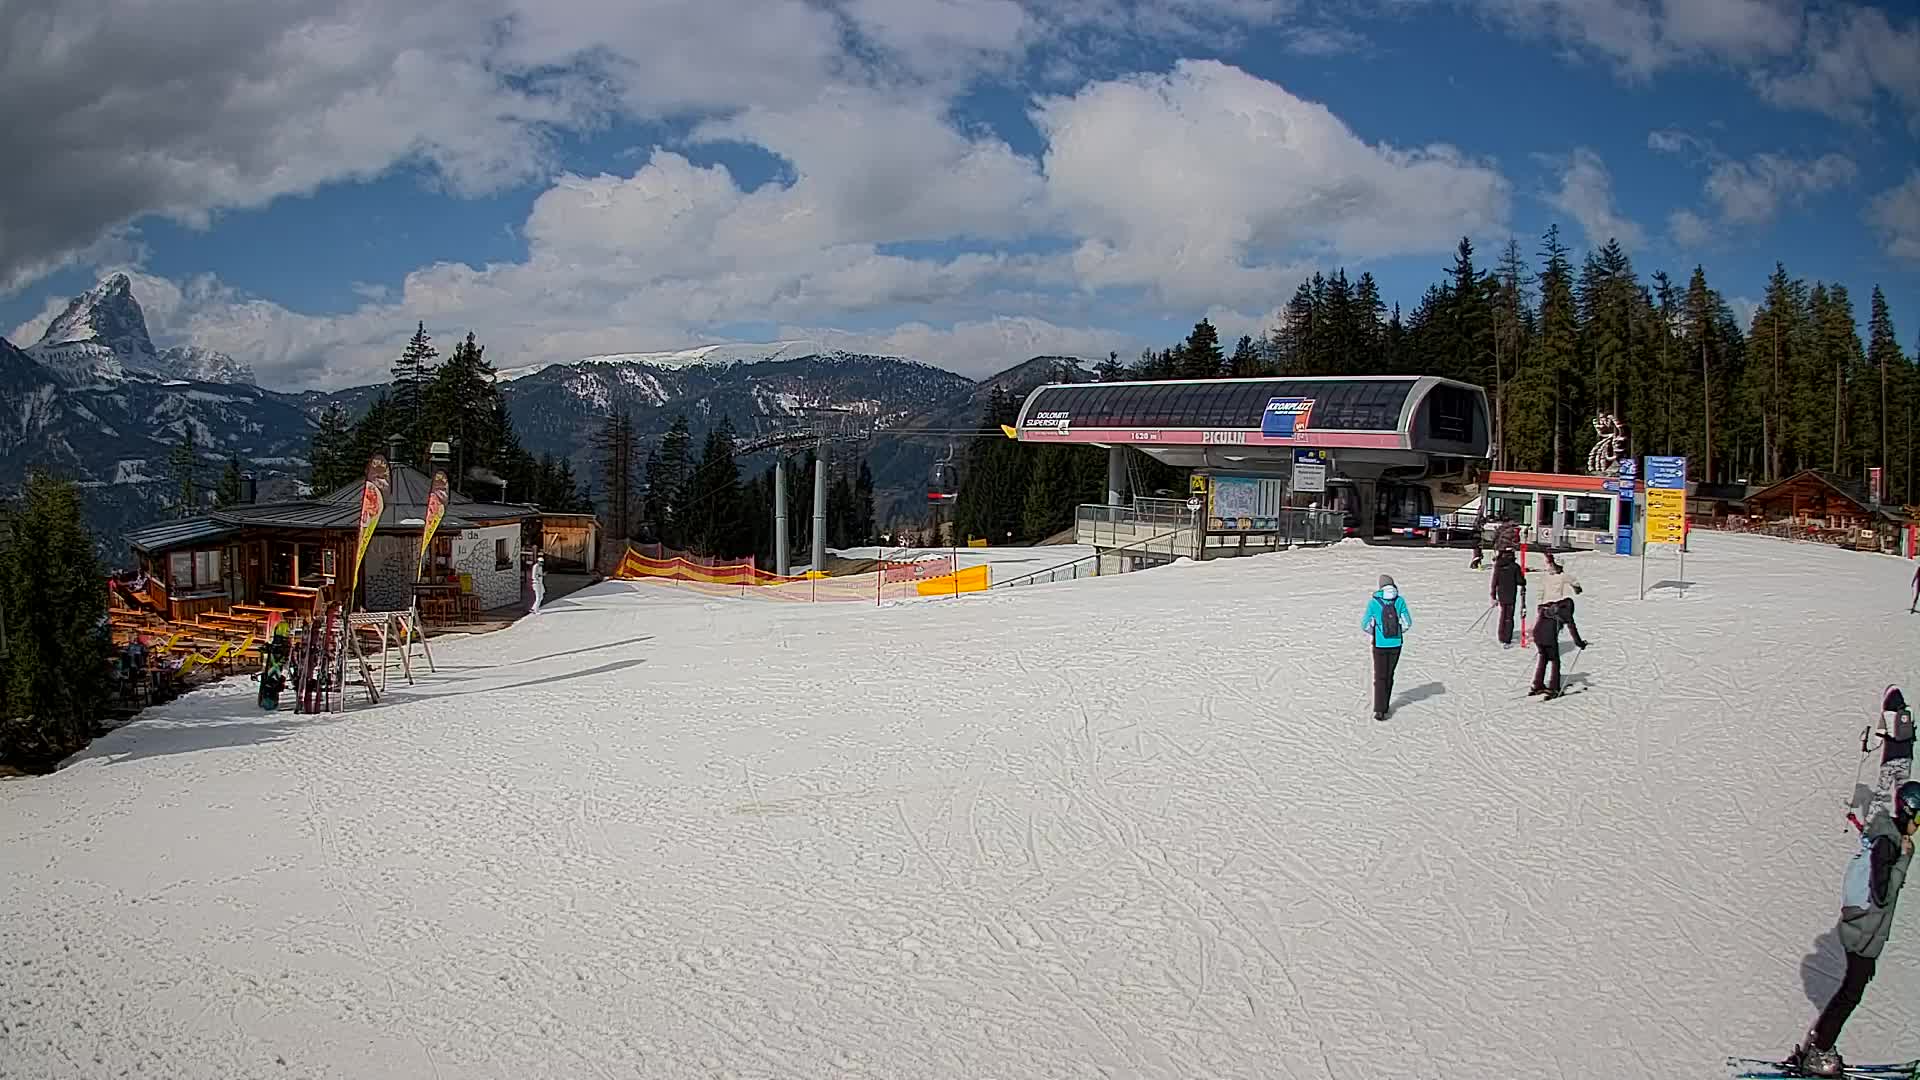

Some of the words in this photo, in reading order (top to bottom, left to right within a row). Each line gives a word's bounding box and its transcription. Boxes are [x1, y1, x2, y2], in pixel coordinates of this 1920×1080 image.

[1267, 402, 1312, 411] KRONPLATZ
[1131, 432, 1149, 440] 1620
[1202, 432, 1246, 444] PICULIN
